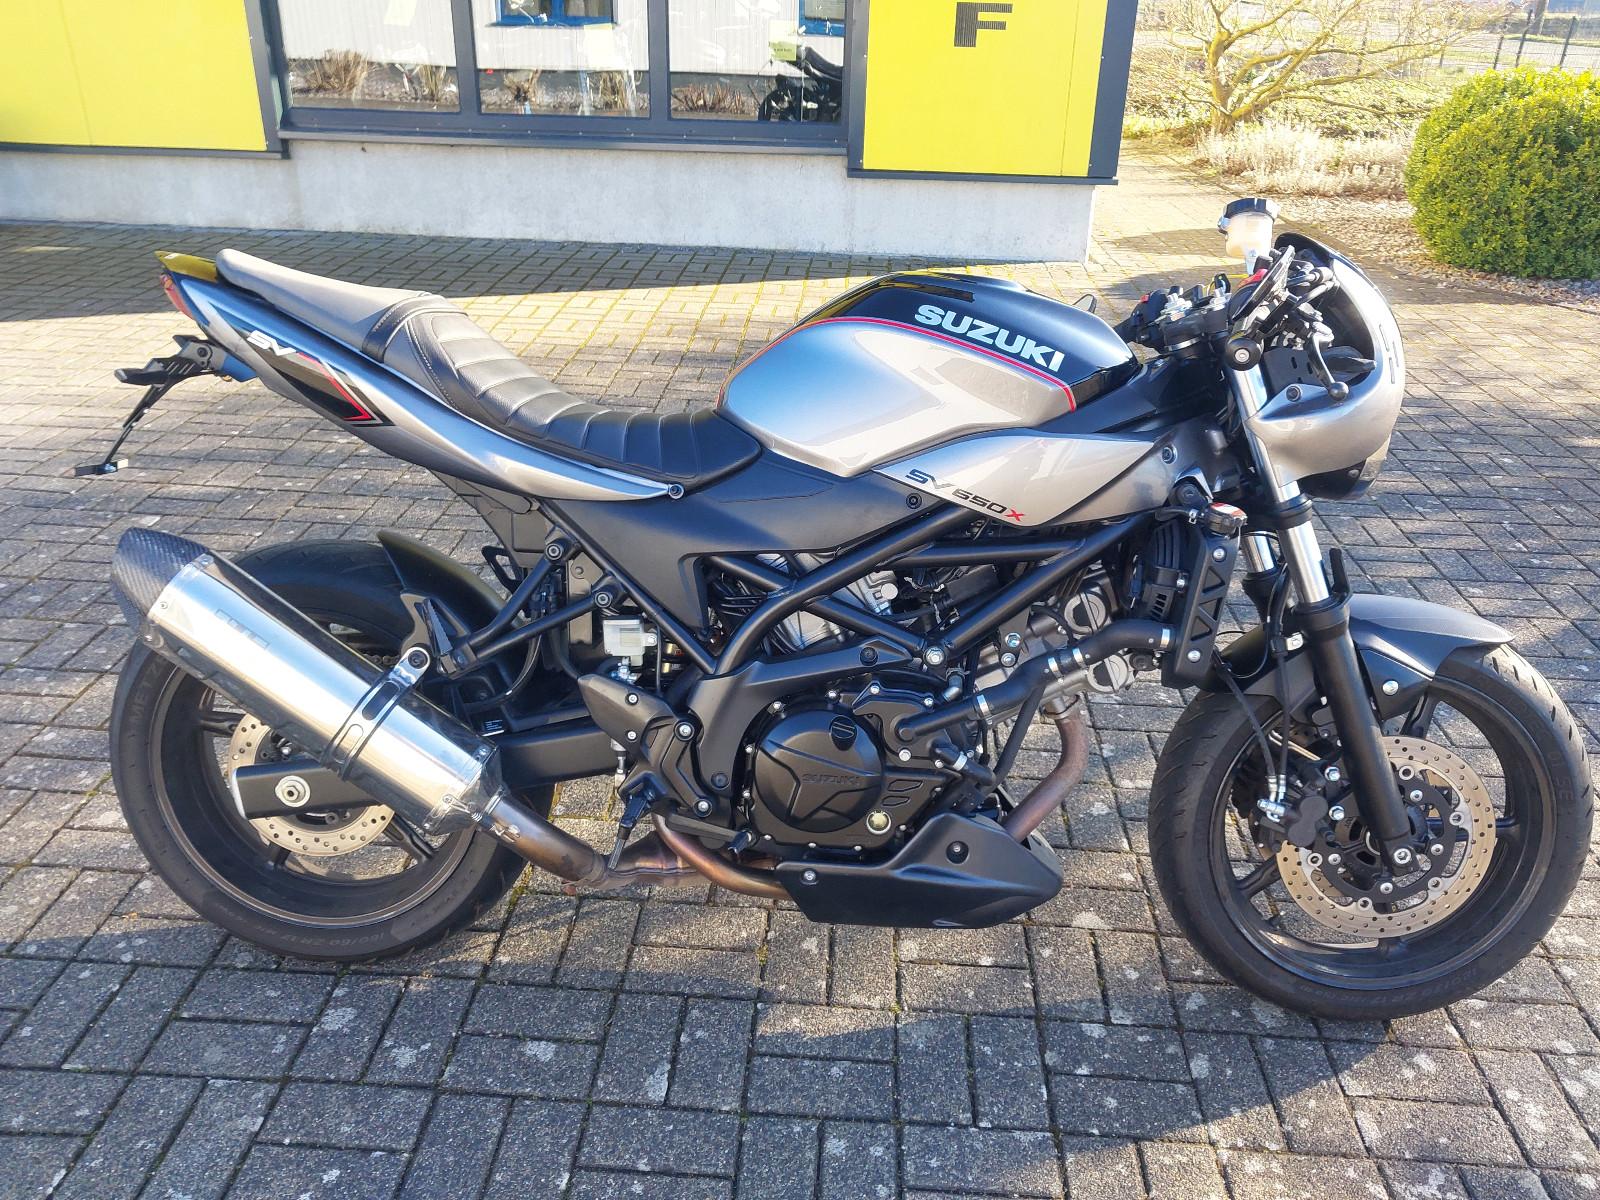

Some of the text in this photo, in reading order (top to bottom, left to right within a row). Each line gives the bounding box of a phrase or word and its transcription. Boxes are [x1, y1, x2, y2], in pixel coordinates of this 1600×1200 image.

[954, 2, 1013, 47] F
[247, 330, 297, 356] SV
[914, 304, 1065, 372] SUZUKI
[905, 468, 1025, 521] SV 650X
[802, 774, 861, 785] SUZUKI
